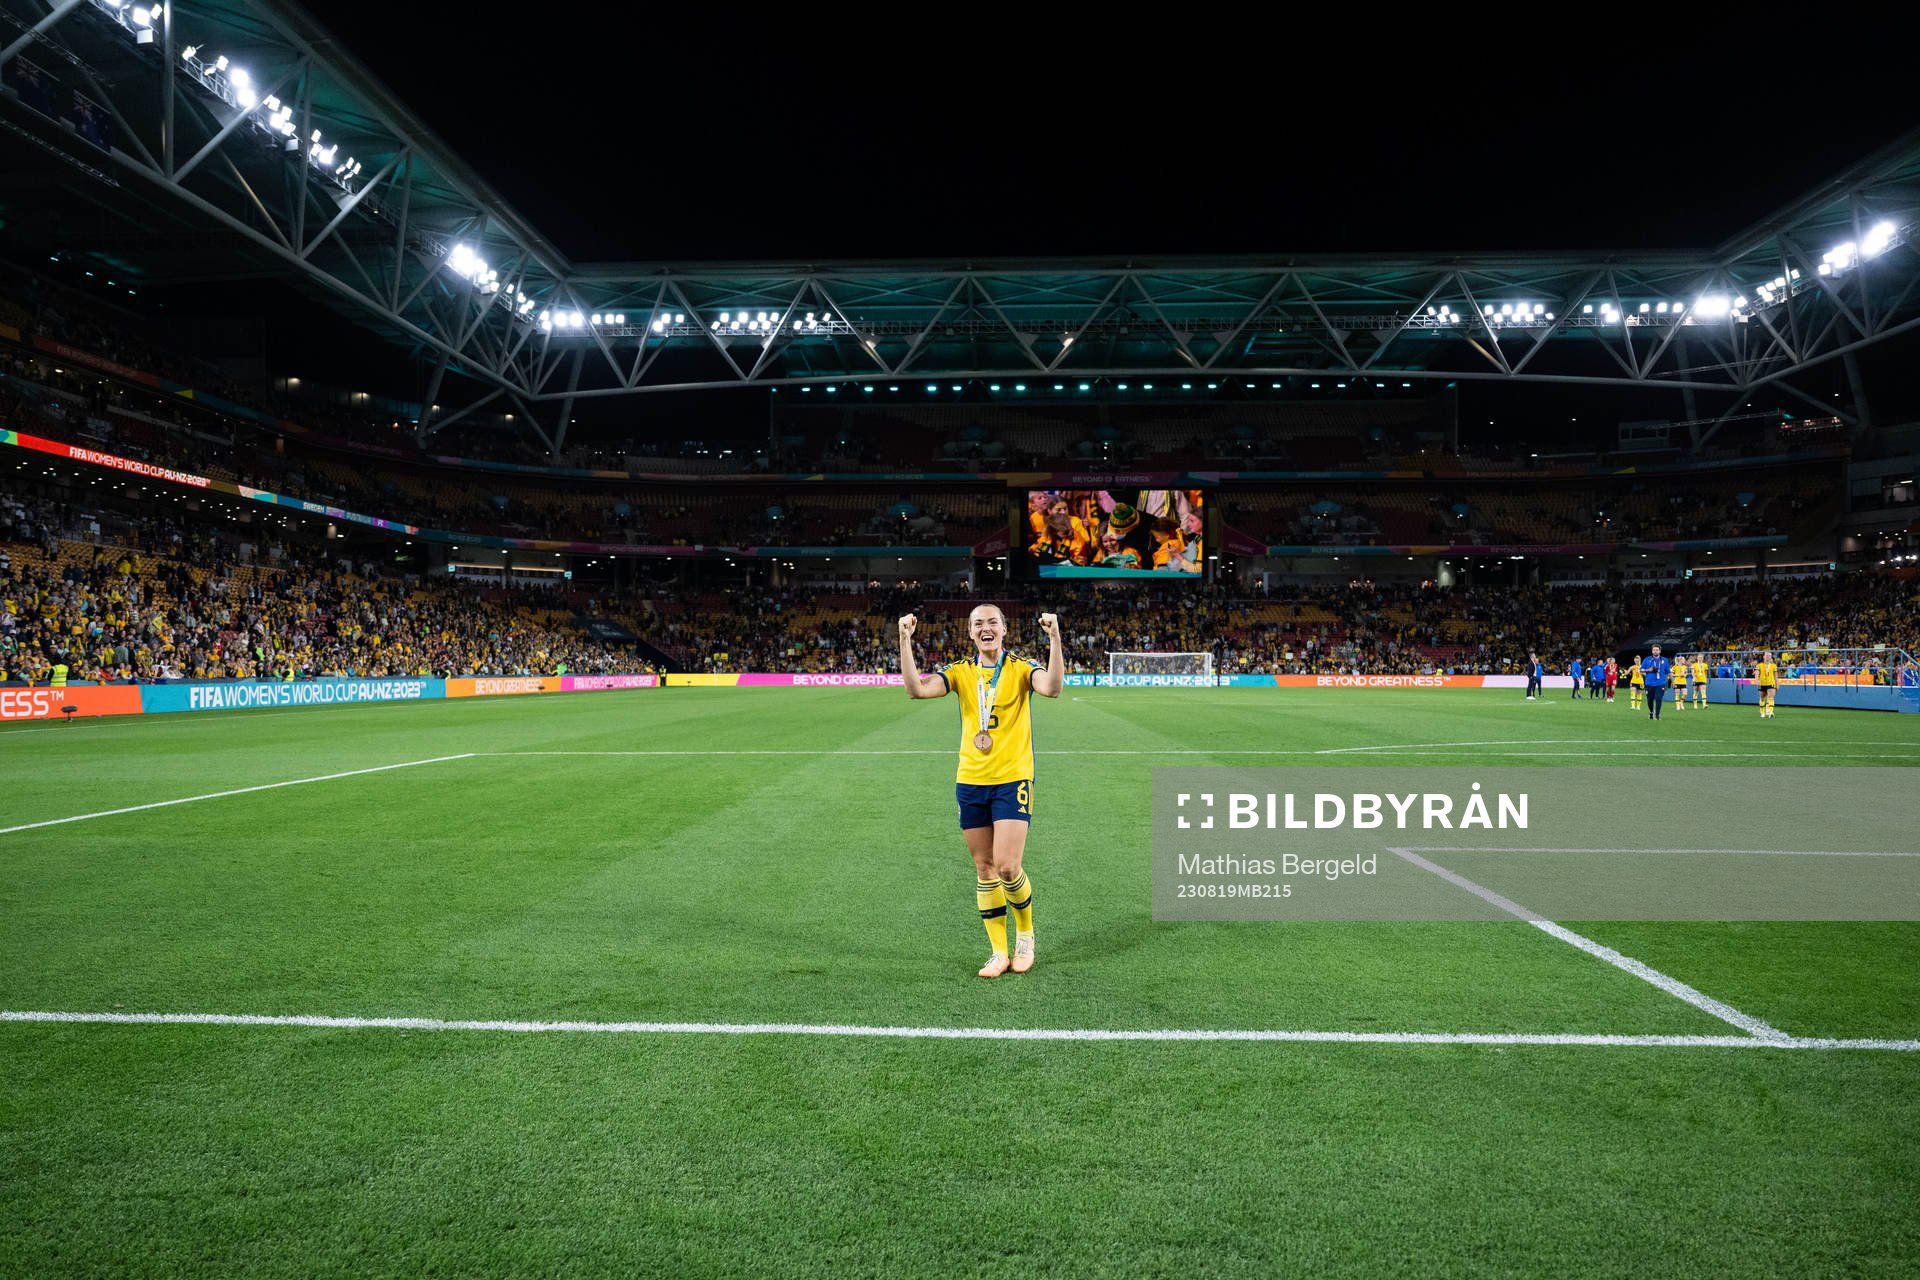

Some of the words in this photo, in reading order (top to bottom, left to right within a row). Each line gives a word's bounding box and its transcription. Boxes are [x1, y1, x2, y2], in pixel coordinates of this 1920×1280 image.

[69, 446, 87, 460] FIFA
[87, 450, 124, 469] WOMEN'S
[124, 459, 150, 476] WORLD
[150, 466, 164, 478] CUP
[303, 501, 325, 514] SWEDEN
[793, 674, 841, 685] BEYOND
[1127, 675, 1151, 686] CUP
[1317, 676, 1367, 687] BEYOND
[190, 686, 224, 708] FIFA
[224, 685, 290, 707] WOMEN'S
[292, 684, 334, 704] WORLD
[336, 683, 358, 701] CUP
[1016, 781, 1029, 805] 6
